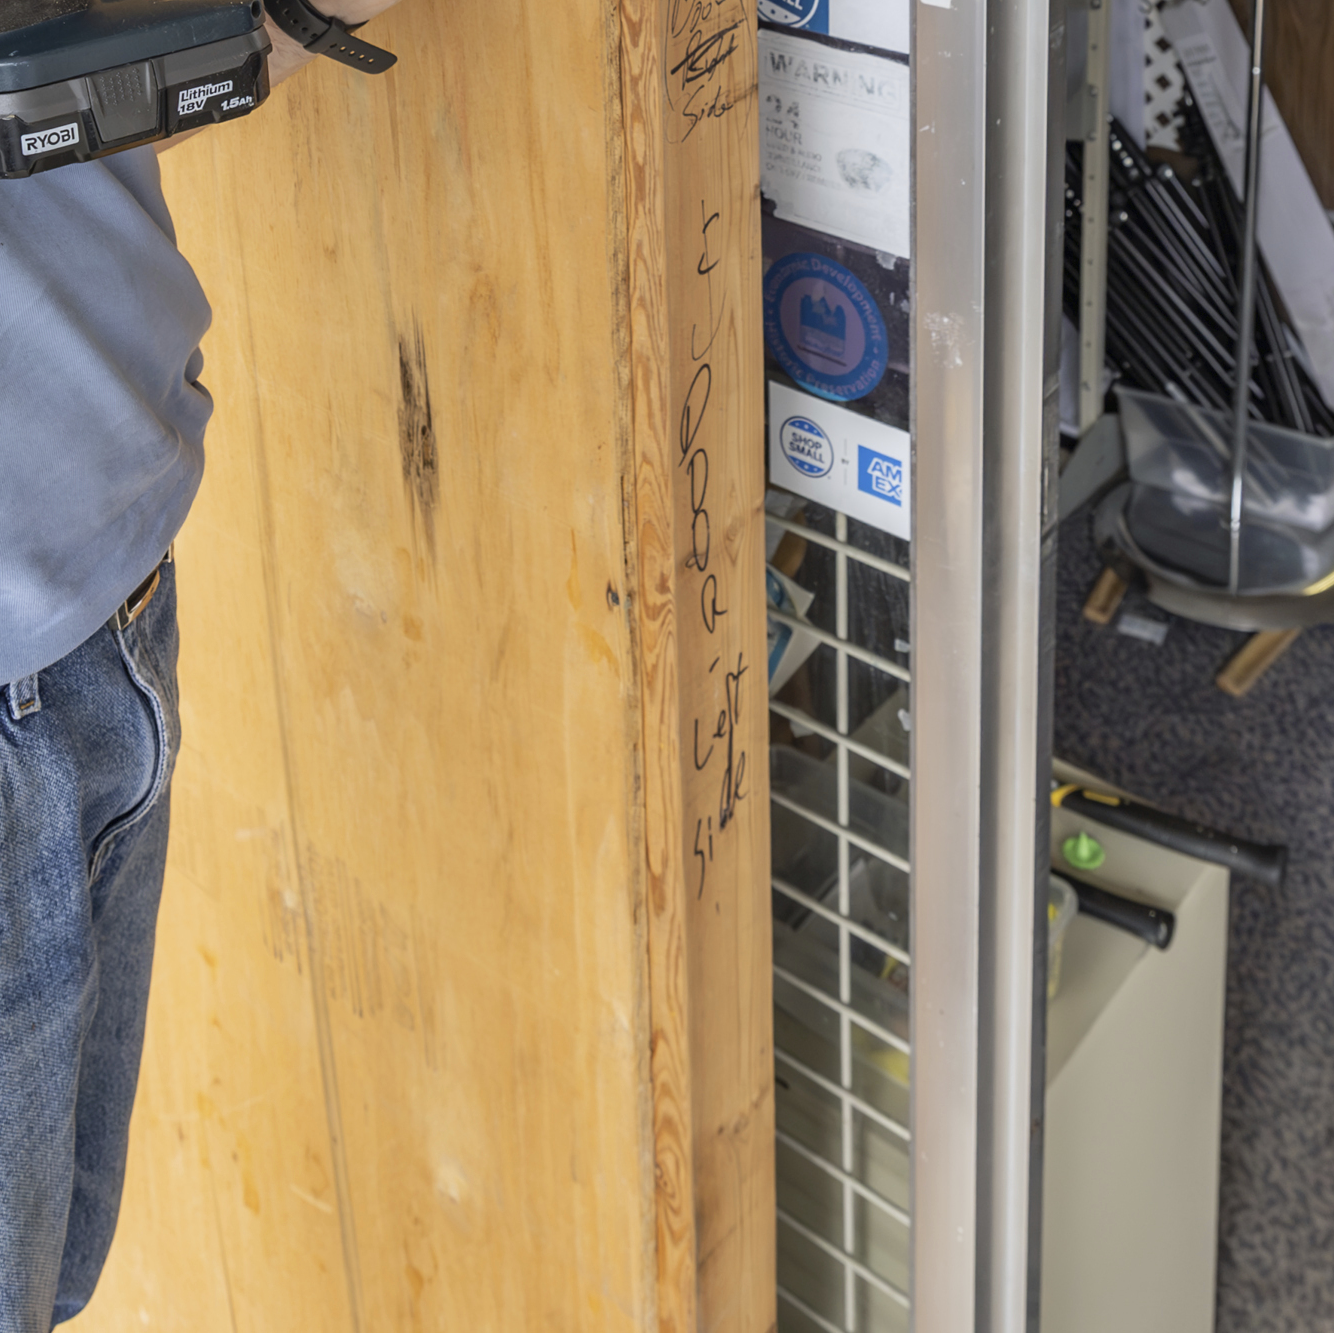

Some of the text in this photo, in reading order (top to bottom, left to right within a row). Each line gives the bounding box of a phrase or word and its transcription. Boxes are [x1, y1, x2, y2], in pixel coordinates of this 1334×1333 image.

[769, 51, 899, 106] WARNNG
[180, 81, 232, 103] Lithium
[220, 95, 254, 112] 1.5Ah
[179, 98, 205, 115] 18V
[25, 127, 75, 151] RYOBI
[811, 258, 882, 341] Development
[805, 359, 881, 396] Preservation
[788, 441, 826, 464] SMALL
[792, 432, 822, 450] SHOP
[867, 457, 902, 483] AM
[873, 474, 903, 500] EX
